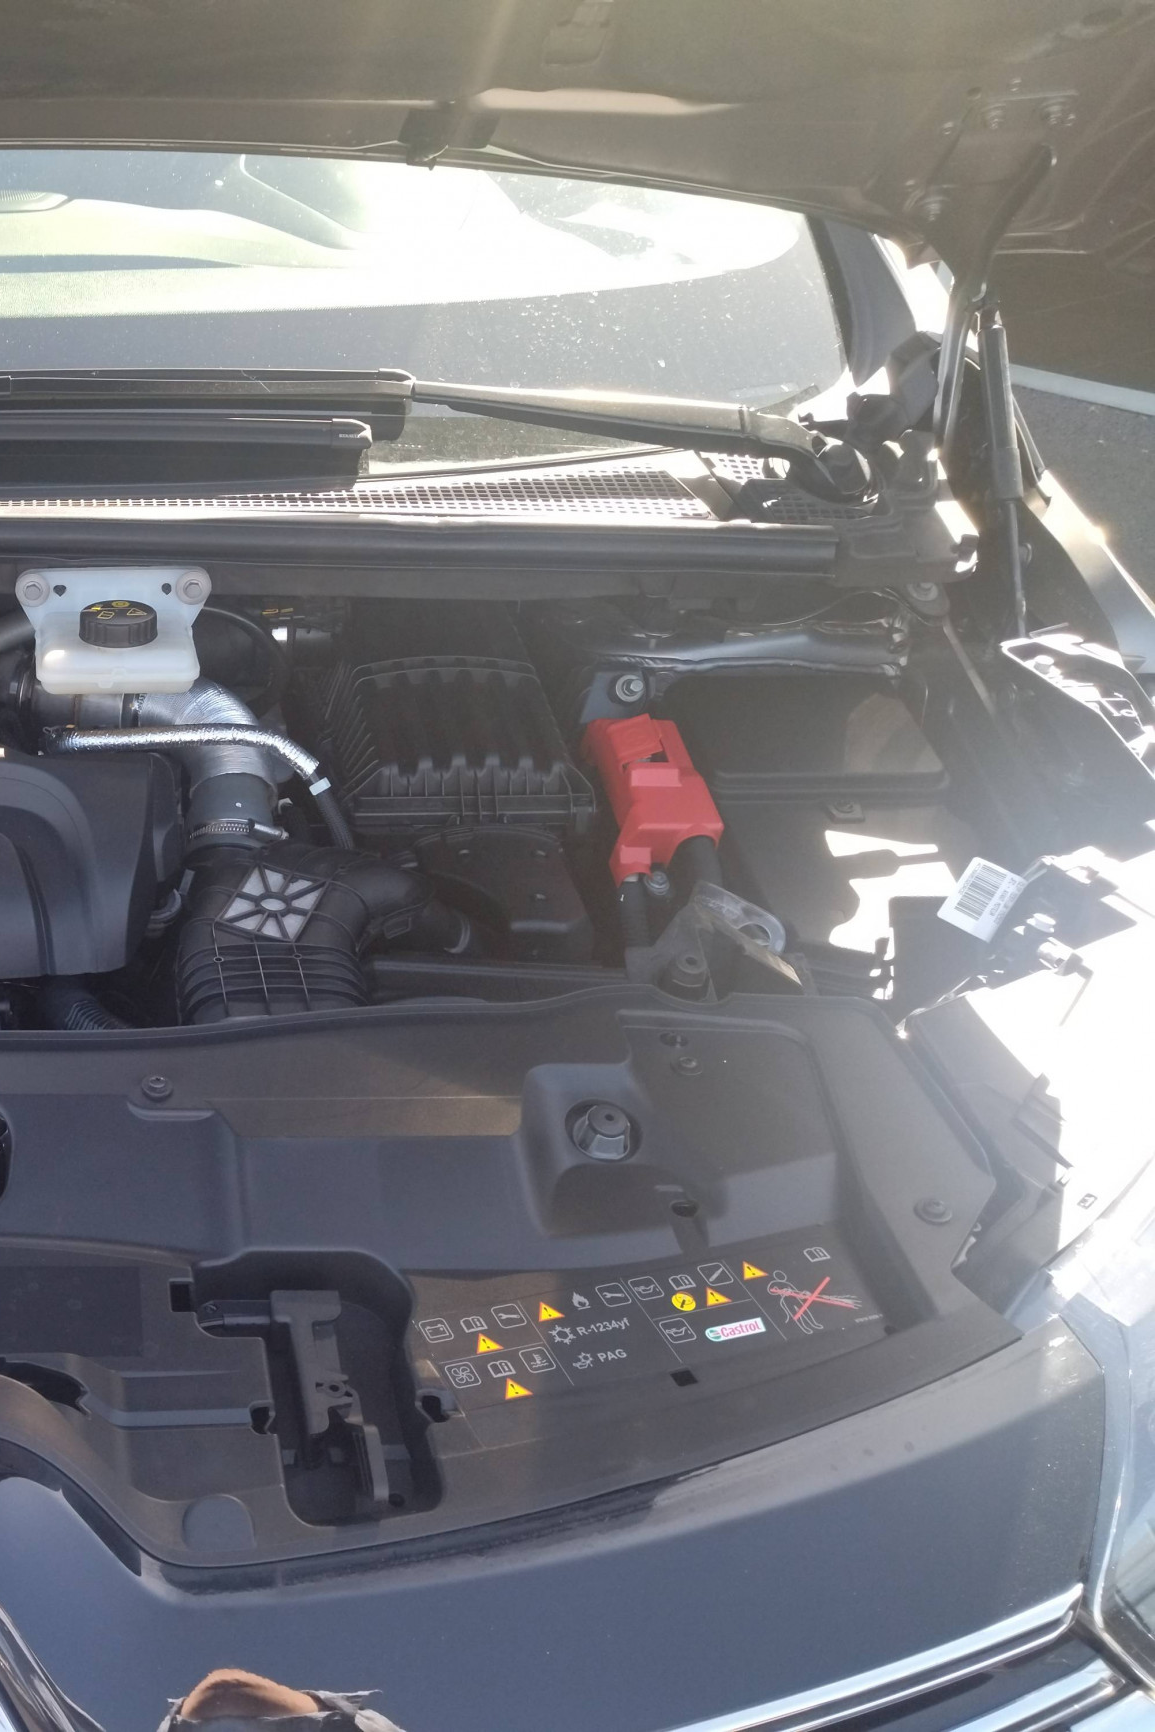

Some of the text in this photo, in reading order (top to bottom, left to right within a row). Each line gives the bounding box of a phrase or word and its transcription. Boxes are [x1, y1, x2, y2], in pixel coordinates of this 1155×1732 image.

[576, 1317, 630, 1336] R-1234yf
[720, 1320, 762, 1338] Castrol
[597, 1349, 627, 1362] PAG
